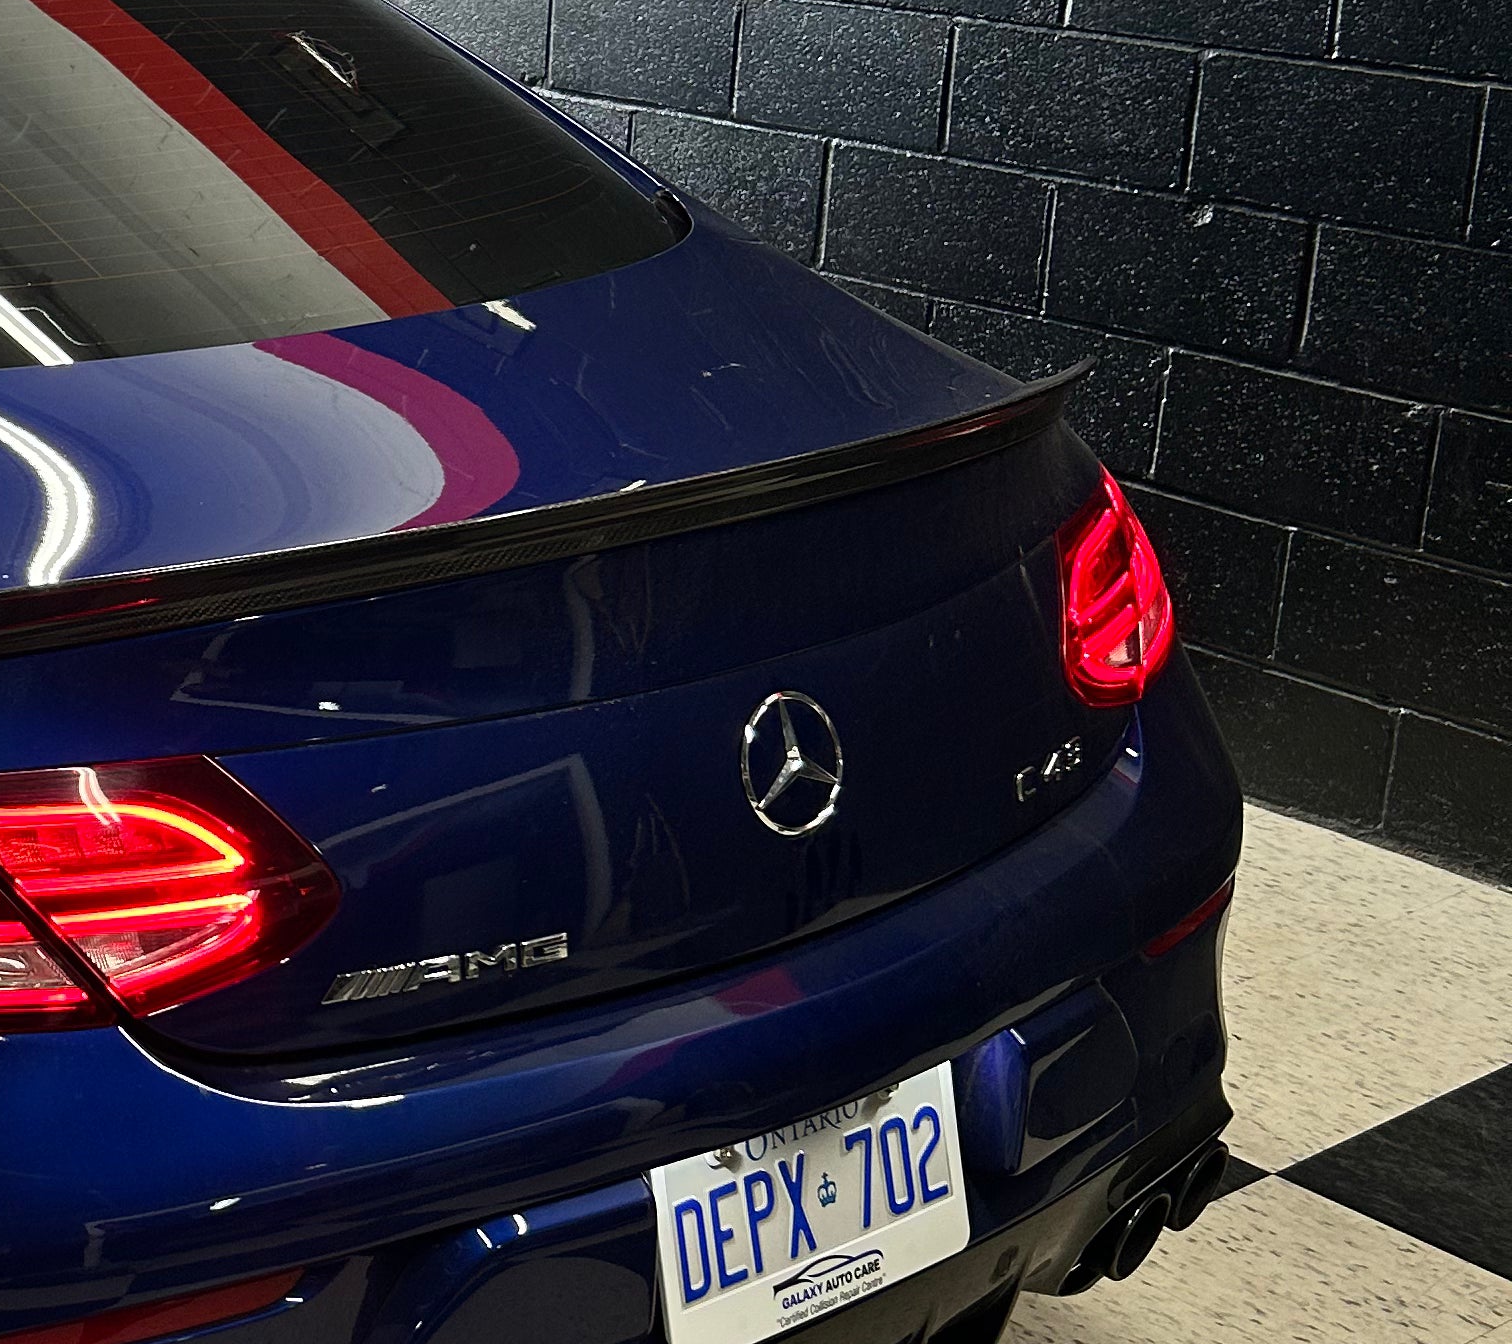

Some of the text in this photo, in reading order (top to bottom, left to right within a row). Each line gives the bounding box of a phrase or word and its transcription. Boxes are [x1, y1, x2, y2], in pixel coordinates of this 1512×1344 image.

[402, 931, 569, 993] AMG
[674, 1104, 950, 1304] DEPX 702
[781, 1258, 882, 1310] GALAXY AUTO CARE
